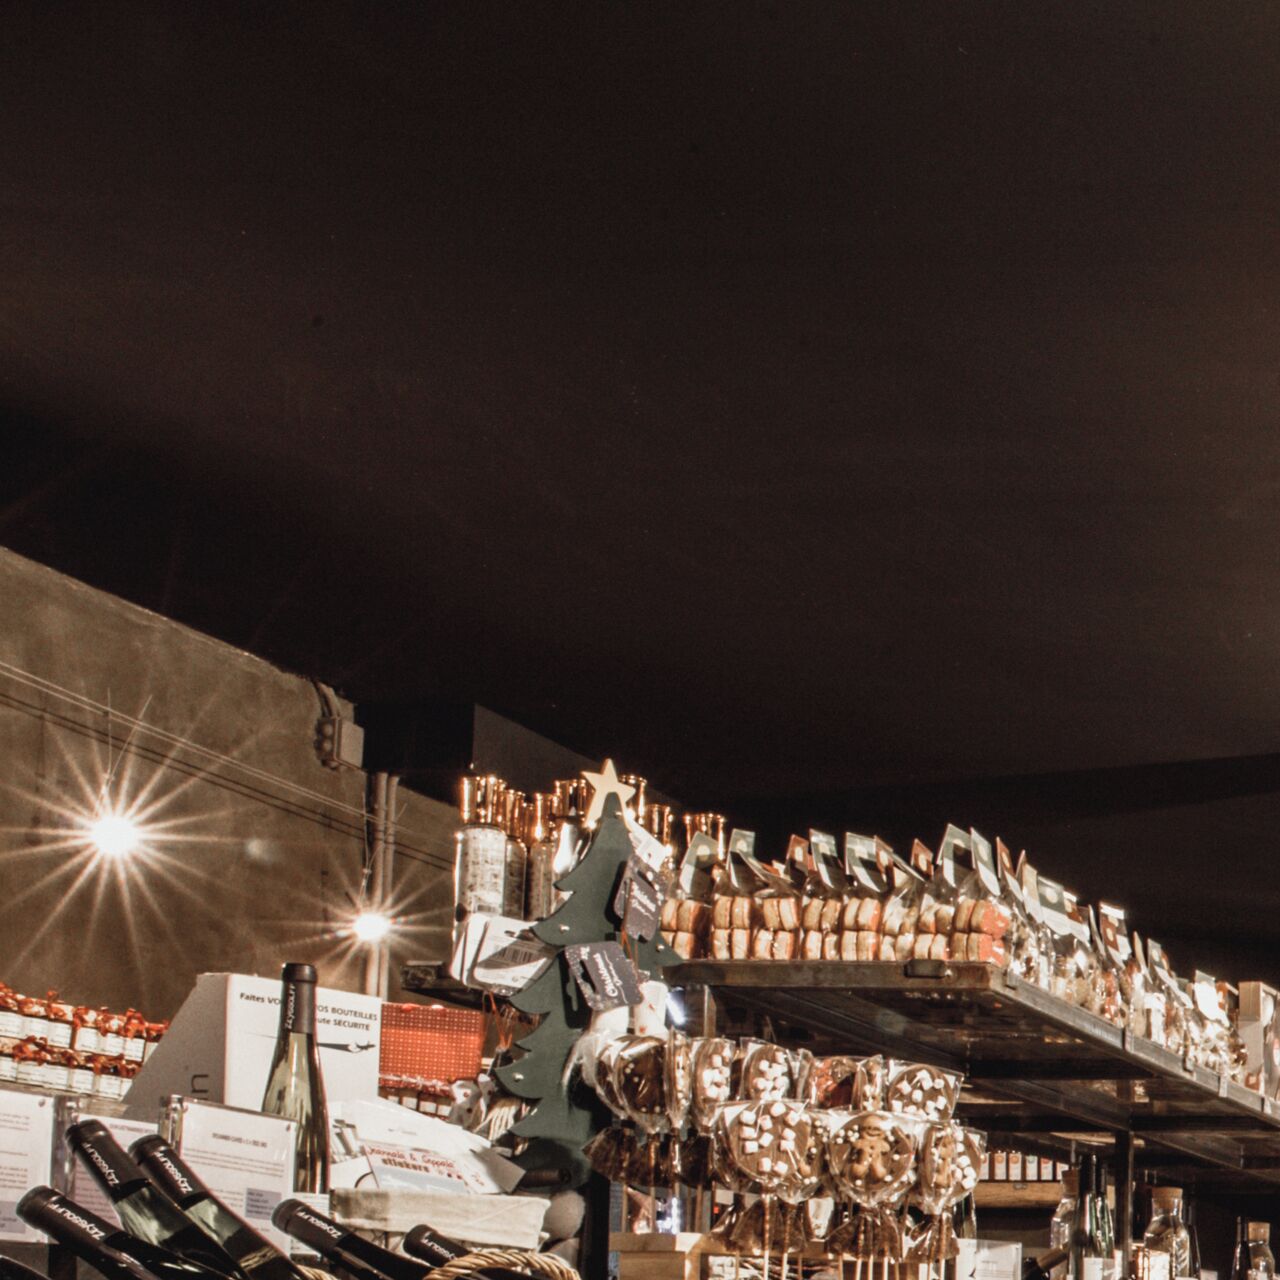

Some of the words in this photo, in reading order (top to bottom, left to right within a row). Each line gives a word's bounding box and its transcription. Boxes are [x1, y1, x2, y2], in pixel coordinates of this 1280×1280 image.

[239, 992, 266, 1003] Faites
[316, 1004, 329, 1013] OS
[330, 1007, 378, 1022] BOUTEILLES
[316, 1017, 331, 1025] ute
